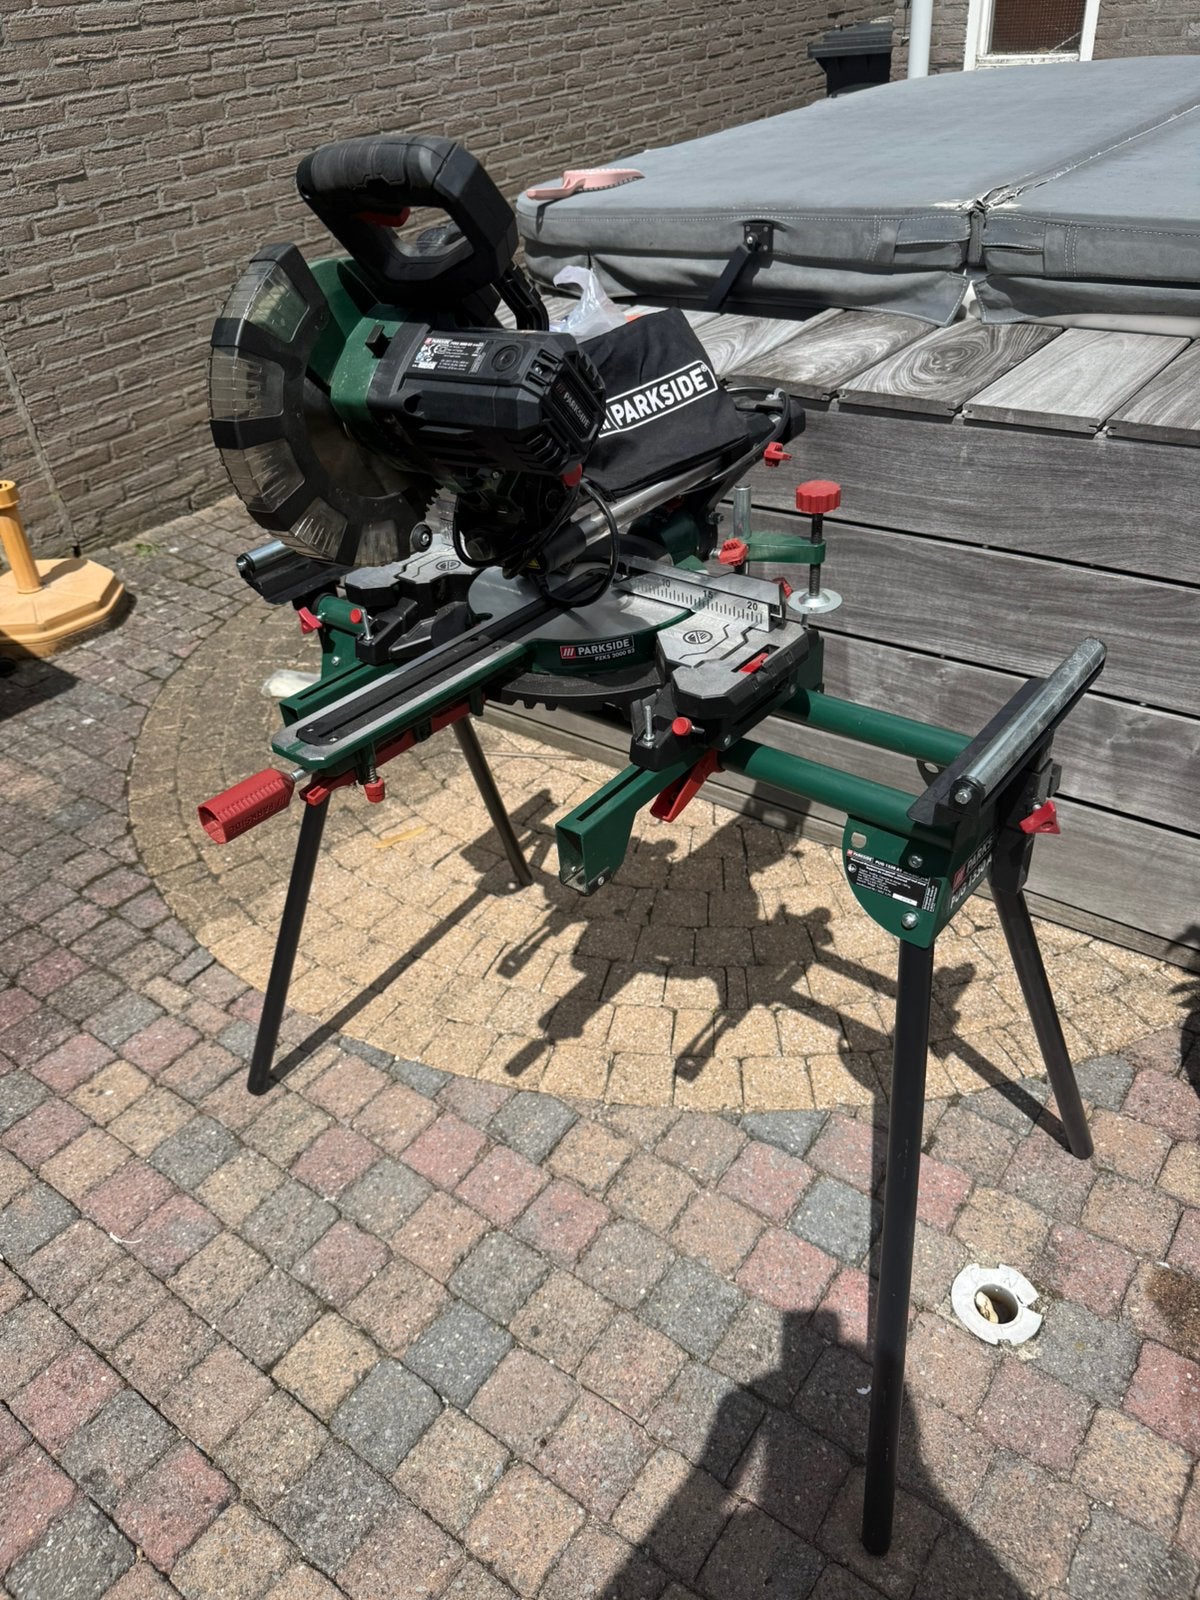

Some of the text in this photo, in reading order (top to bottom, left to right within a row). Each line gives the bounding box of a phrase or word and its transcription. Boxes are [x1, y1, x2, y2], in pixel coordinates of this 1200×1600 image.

[610, 368, 708, 426] PARKSIDE
[563, 391, 591, 429] PARKSIDE
[661, 578, 671, 588] 10
[703, 589, 714, 600] 15
[746, 600, 758, 611] 20
[577, 638, 630, 656] PARKSIDE
